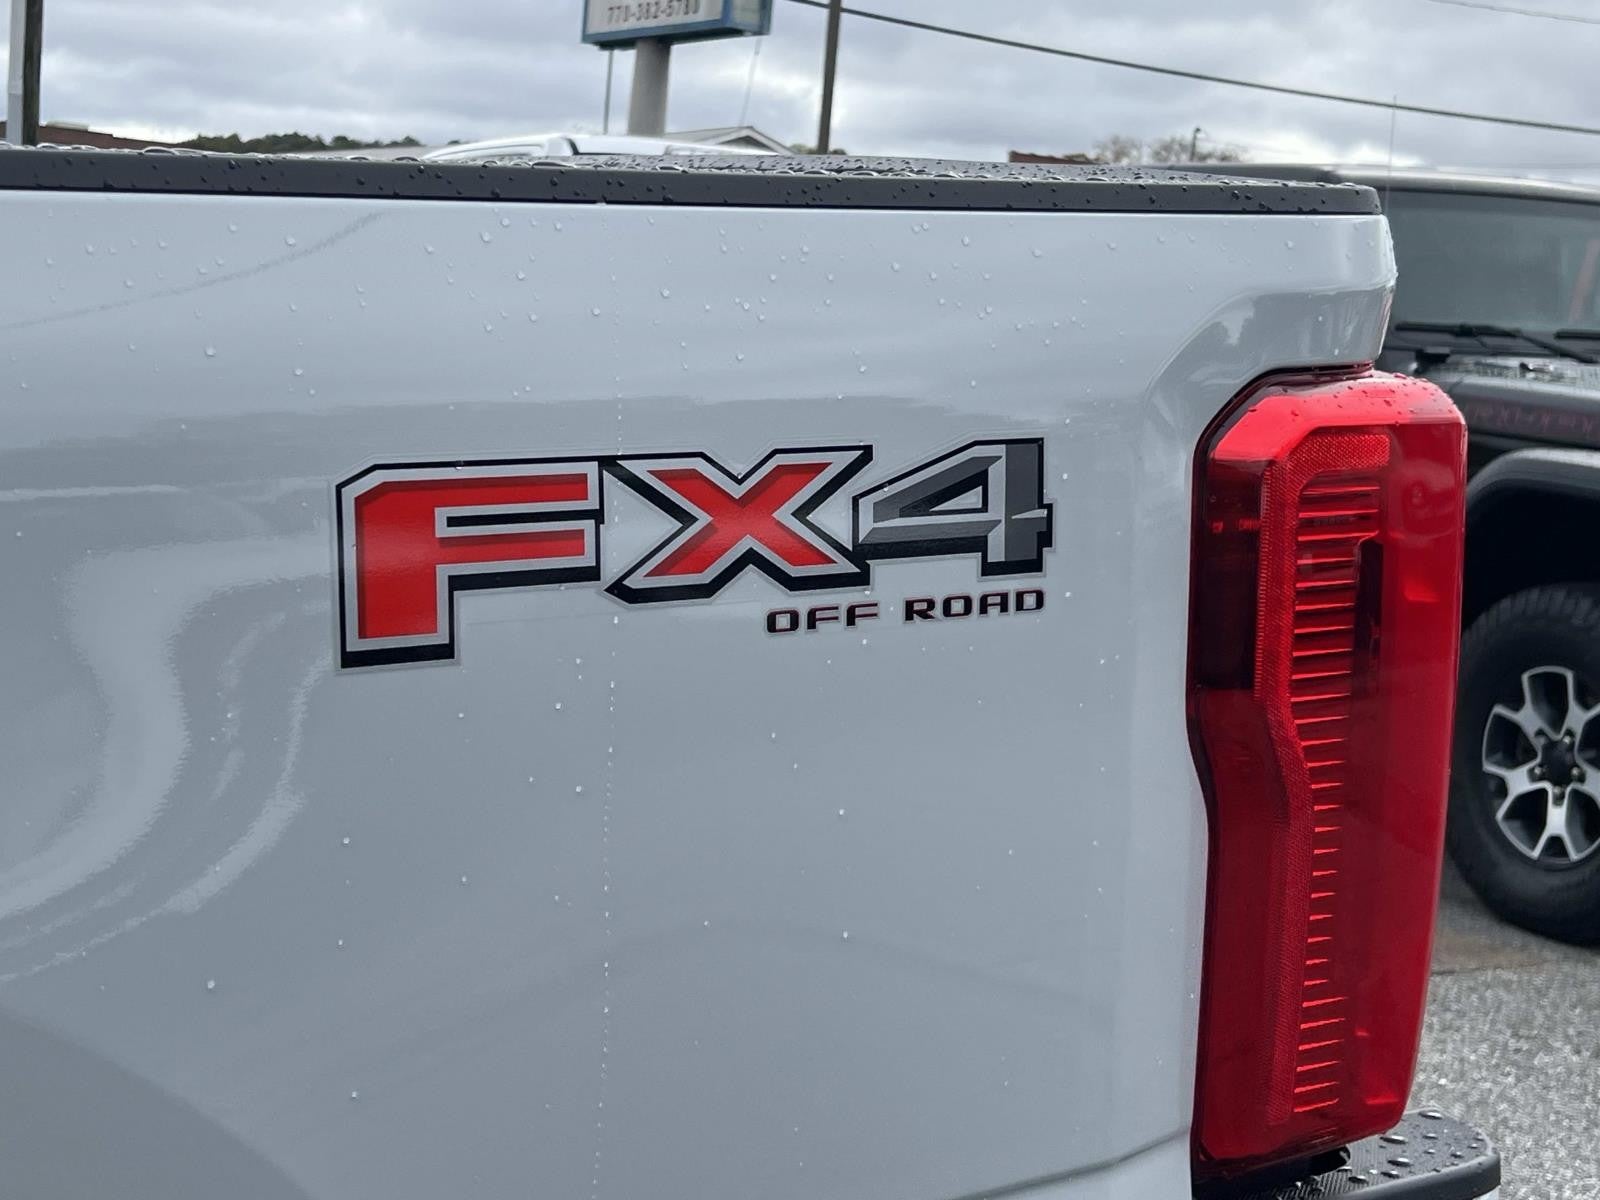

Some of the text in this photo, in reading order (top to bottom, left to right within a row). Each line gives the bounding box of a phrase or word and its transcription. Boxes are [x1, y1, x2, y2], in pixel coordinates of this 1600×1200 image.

[335, 439, 1054, 669] FX4
[766, 588, 1046, 634] OFF ROAD
